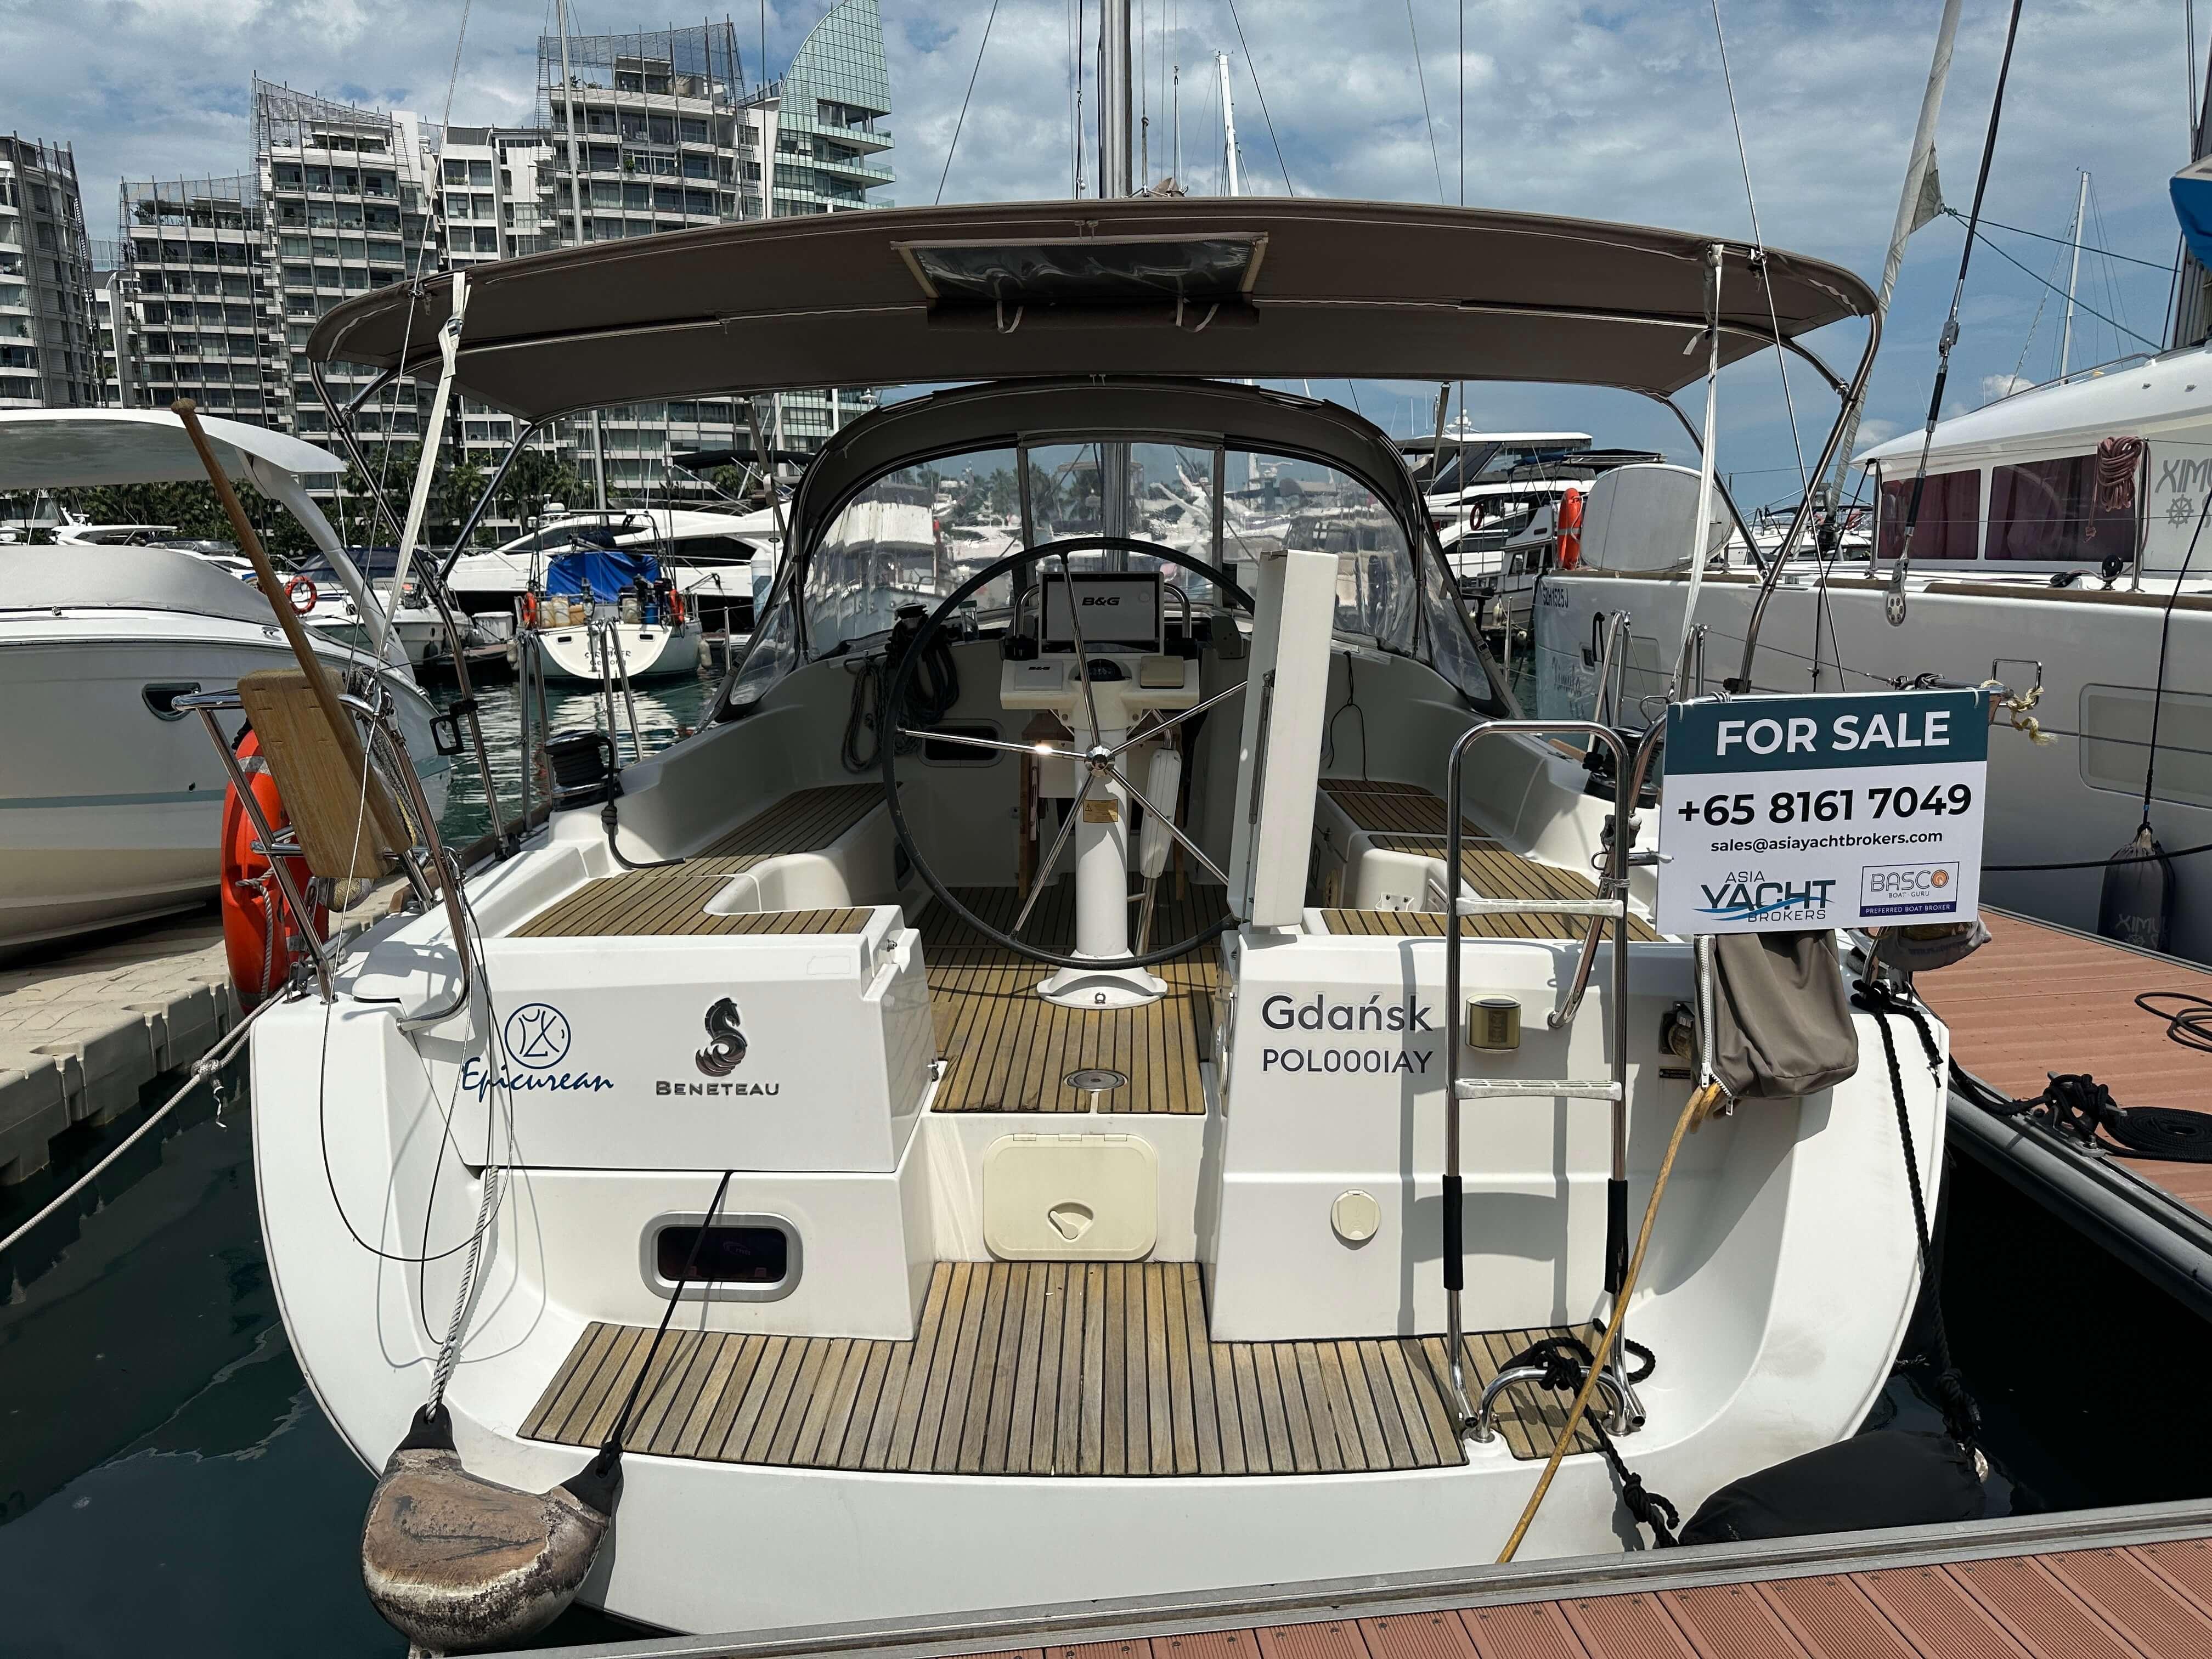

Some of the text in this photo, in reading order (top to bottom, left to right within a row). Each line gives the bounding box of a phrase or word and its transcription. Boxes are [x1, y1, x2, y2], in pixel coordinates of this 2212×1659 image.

[1081, 597, 1120, 606] B&G
[1717, 710, 1950, 756] FOR SALE
[1678, 783, 1972, 826] +65 8161 7049
[1711, 831, 1943, 854] sales@asiayachtbrokers.com
[1725, 871, 1765, 883] ASIA
[1871, 870, 1949, 892] BASCO
[1701, 879, 1836, 911] YACHT
[1748, 910, 1826, 922] BROKERS
[1262, 994, 1434, 1032] Gdańsk
[462, 1057, 614, 1103] Epicurean
[656, 1080, 780, 1096] BENETEAU
